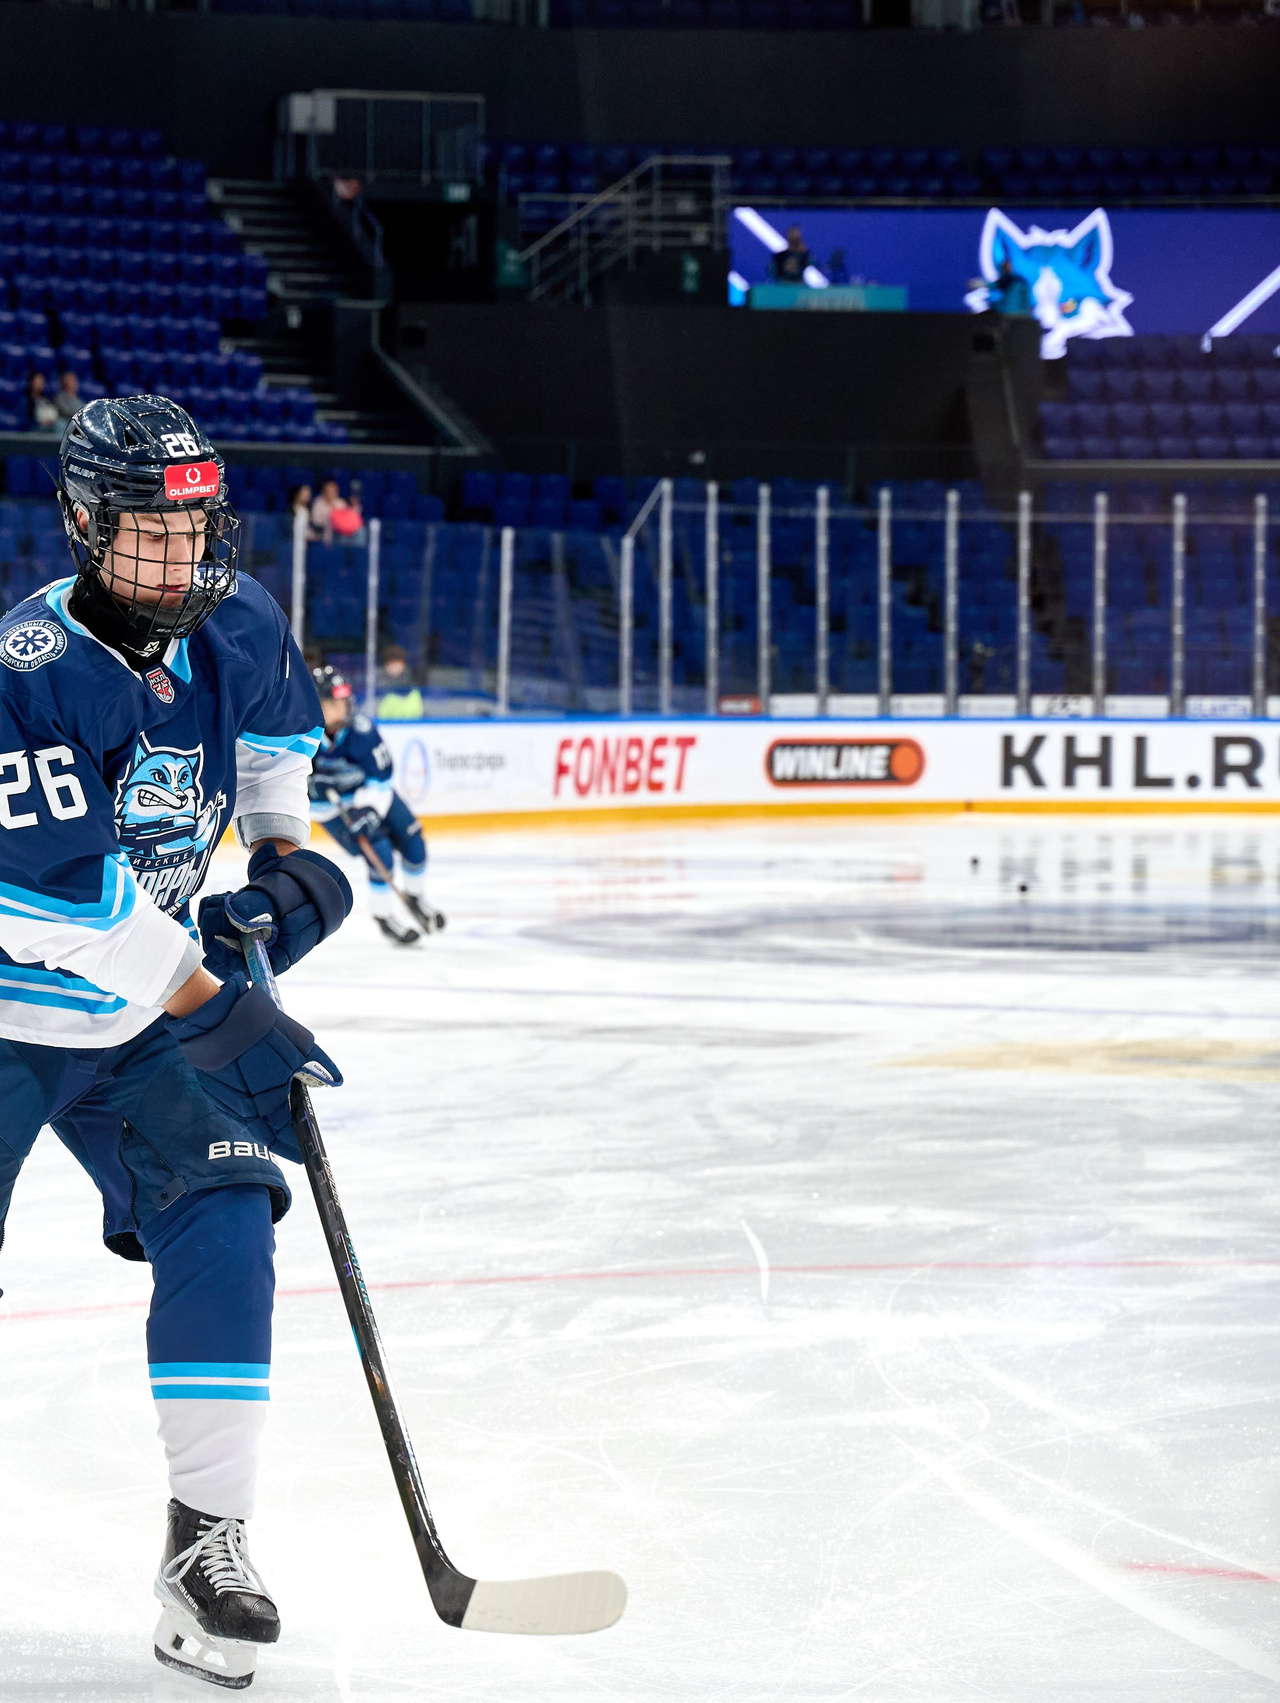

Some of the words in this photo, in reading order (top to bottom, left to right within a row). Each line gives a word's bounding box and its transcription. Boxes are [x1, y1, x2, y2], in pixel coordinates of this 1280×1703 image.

[160, 432, 200, 458] 26
[169, 484, 216, 497] OLIMPBET
[554, 735, 698, 797] FONBET
[772, 745, 891, 781] WINLINE
[1001, 735, 1280, 789] KHL.R
[128, 852, 188, 868] ИРСКИЕ
[175, 1580, 199, 1612] BAUER
